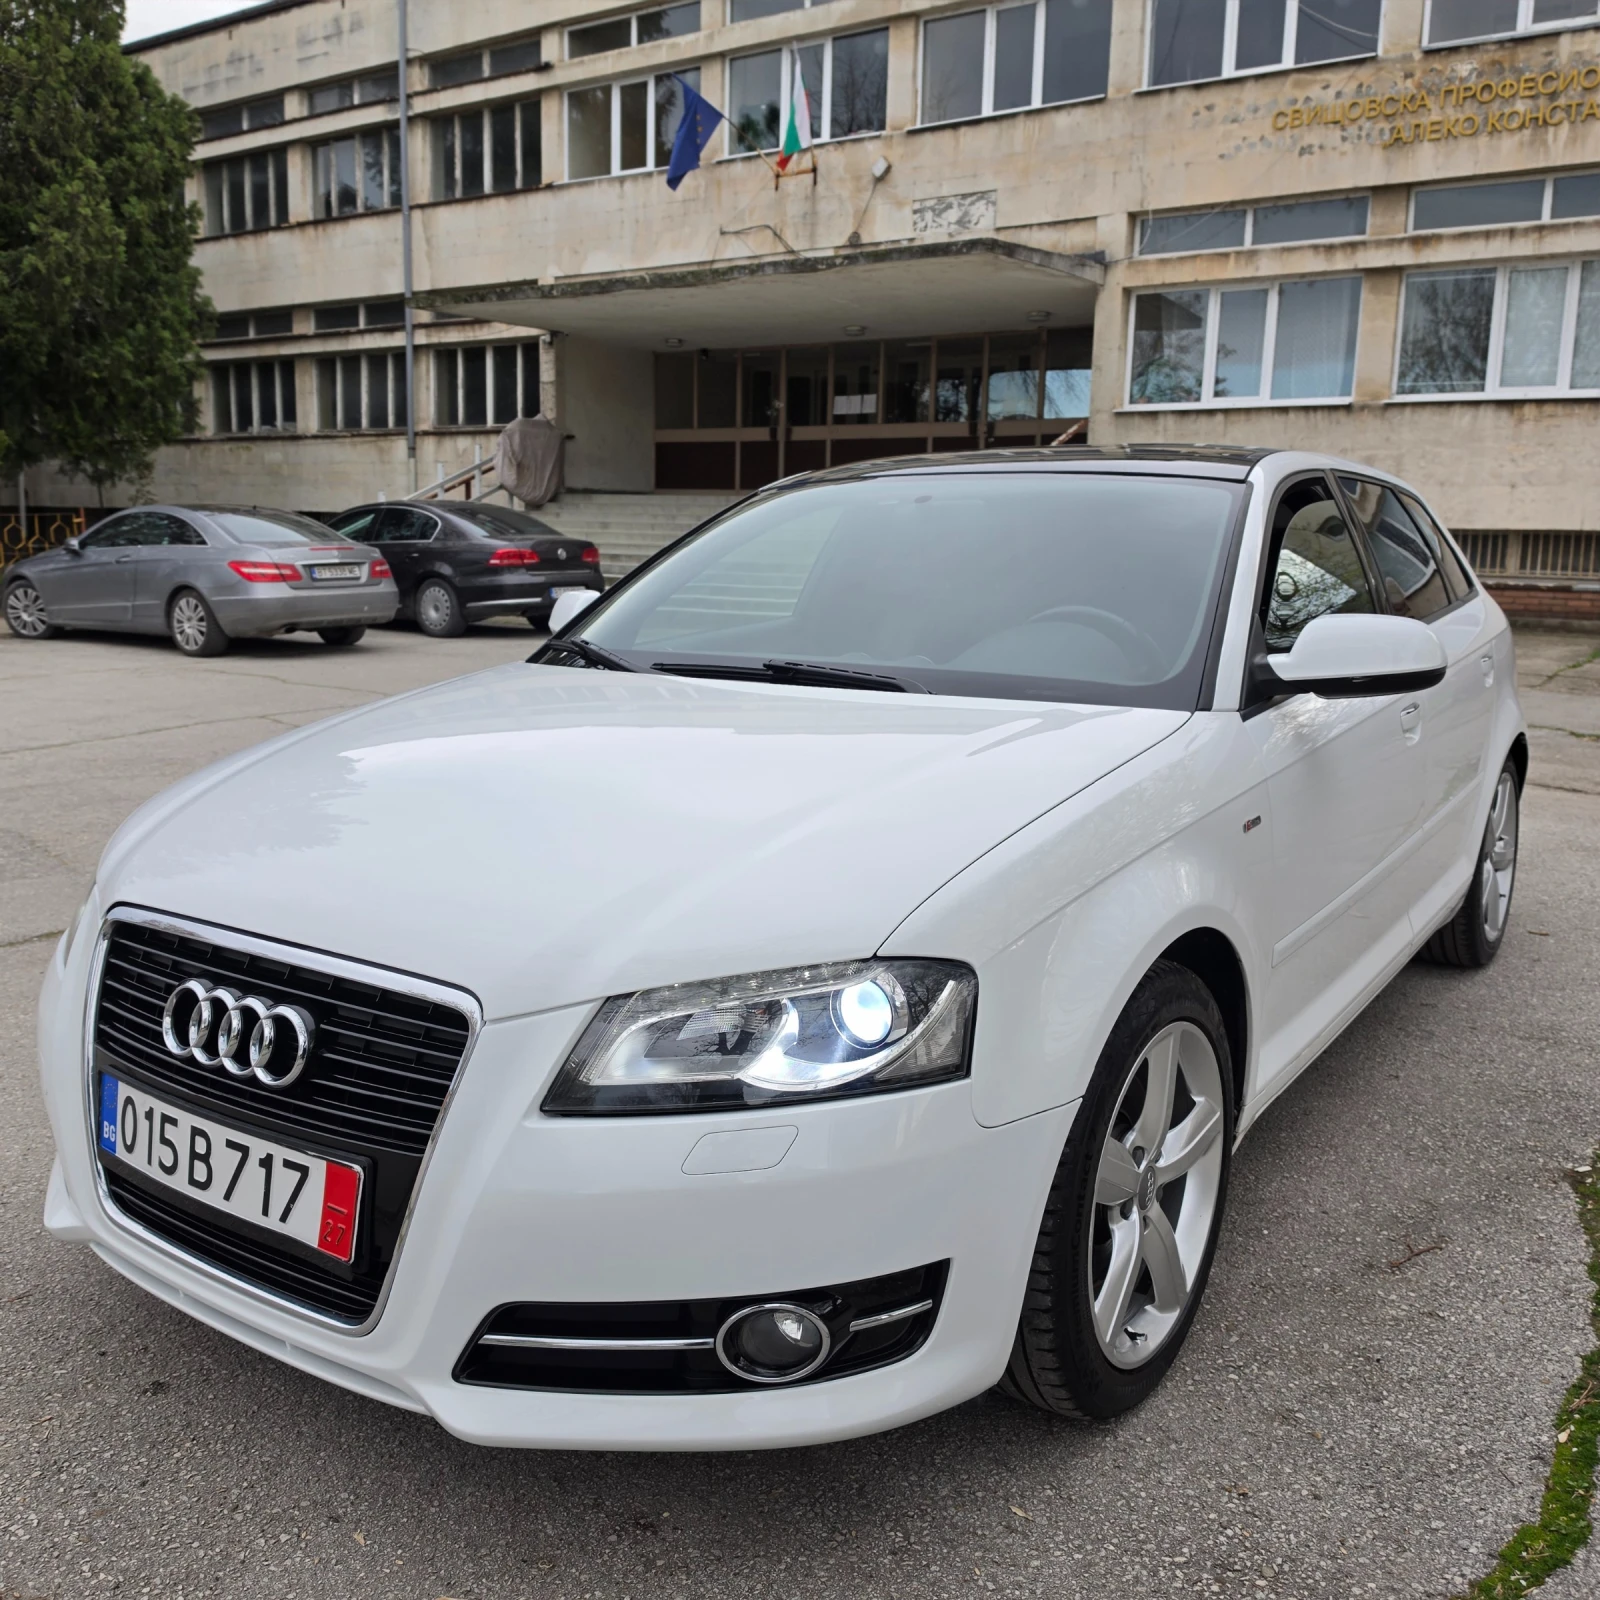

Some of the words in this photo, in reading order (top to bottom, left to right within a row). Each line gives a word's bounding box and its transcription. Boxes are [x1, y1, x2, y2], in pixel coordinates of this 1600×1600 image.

[1271, 90, 1432, 131] СВИЩОВСКА
[103, 1120, 116, 1142] BG
[323, 1219, 346, 1246] 27
